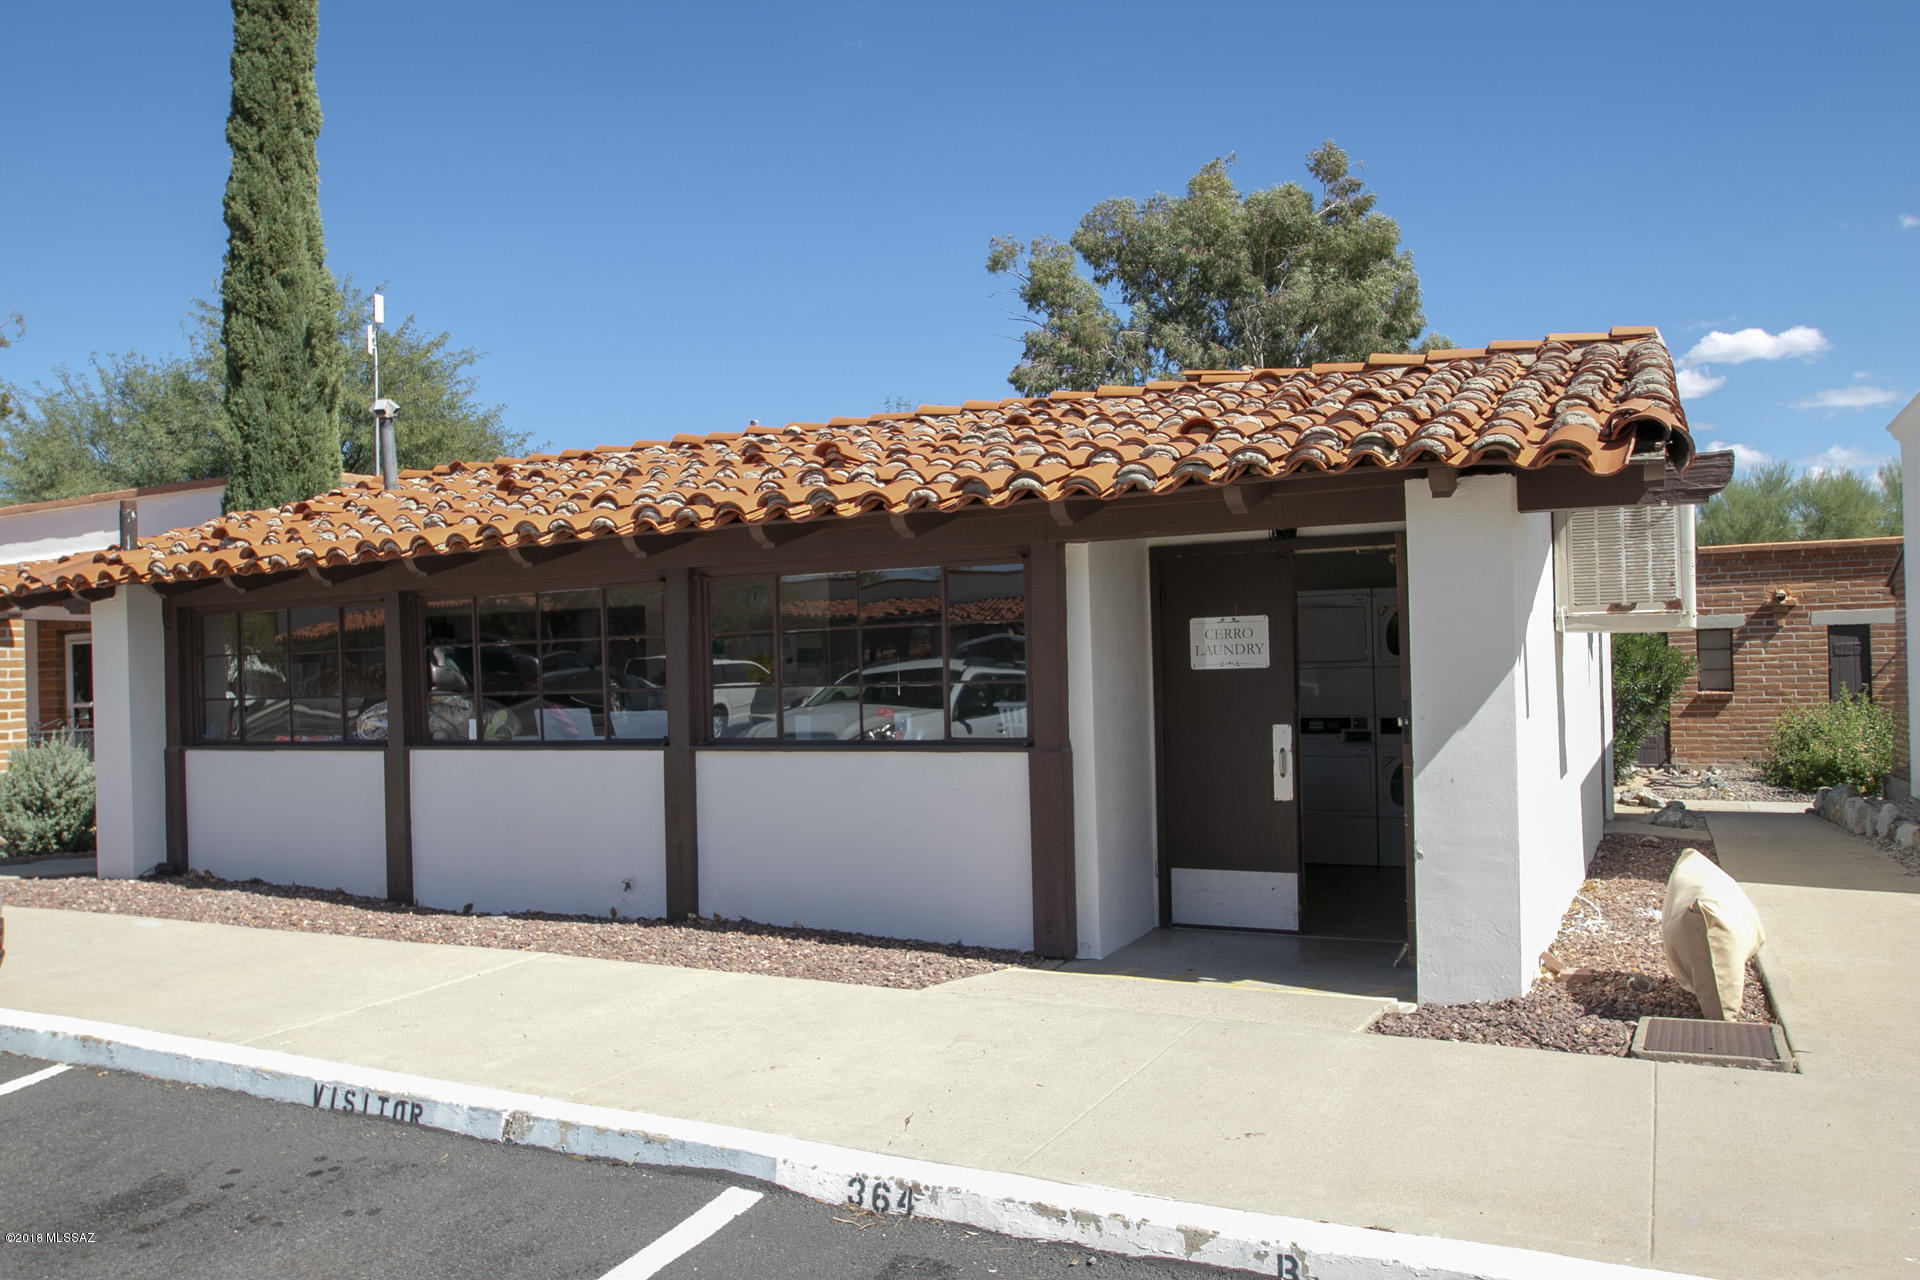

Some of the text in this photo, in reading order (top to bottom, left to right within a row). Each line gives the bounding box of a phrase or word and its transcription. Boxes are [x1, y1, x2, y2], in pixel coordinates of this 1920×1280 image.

[1204, 627, 1254, 640] CERRO
[1194, 642, 1264, 656] LAUNDRY
[314, 1082, 423, 1123] VISITOR
[847, 1177, 914, 1215] 364
